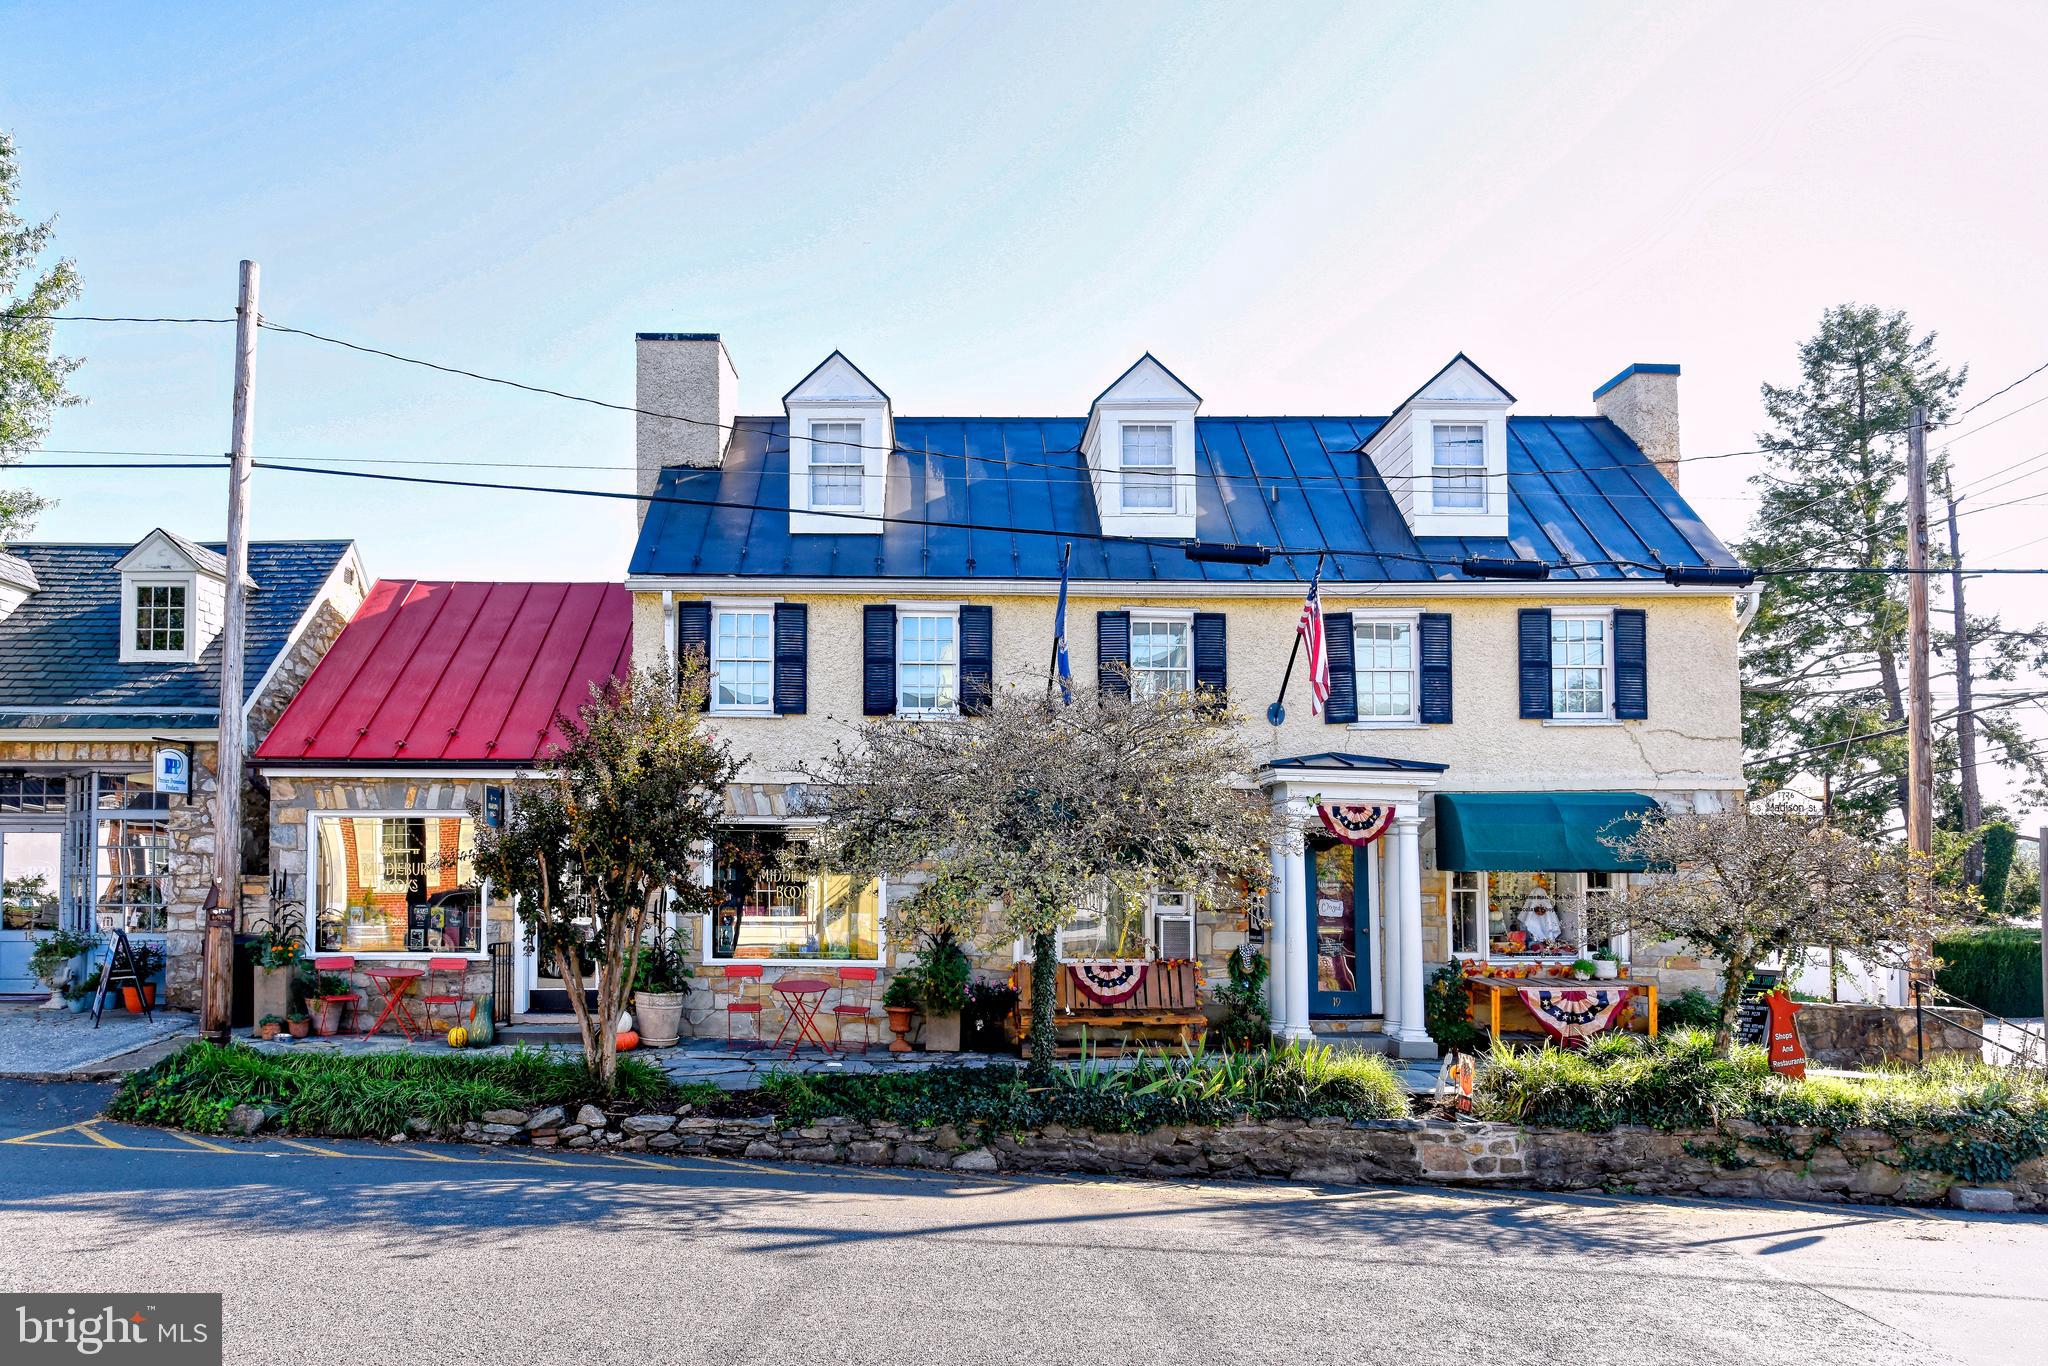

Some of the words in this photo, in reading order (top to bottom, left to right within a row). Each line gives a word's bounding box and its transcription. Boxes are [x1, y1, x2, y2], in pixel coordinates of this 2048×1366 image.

[1767, 801, 1805, 813] Madison
[381, 879, 418, 893] BOOKS
[776, 885, 815, 899] BOOKS
[1332, 997, 1342, 1008] 19
[1775, 1033, 1793, 1041] Shops
[1772, 1057, 1805, 1067] Restaurants
